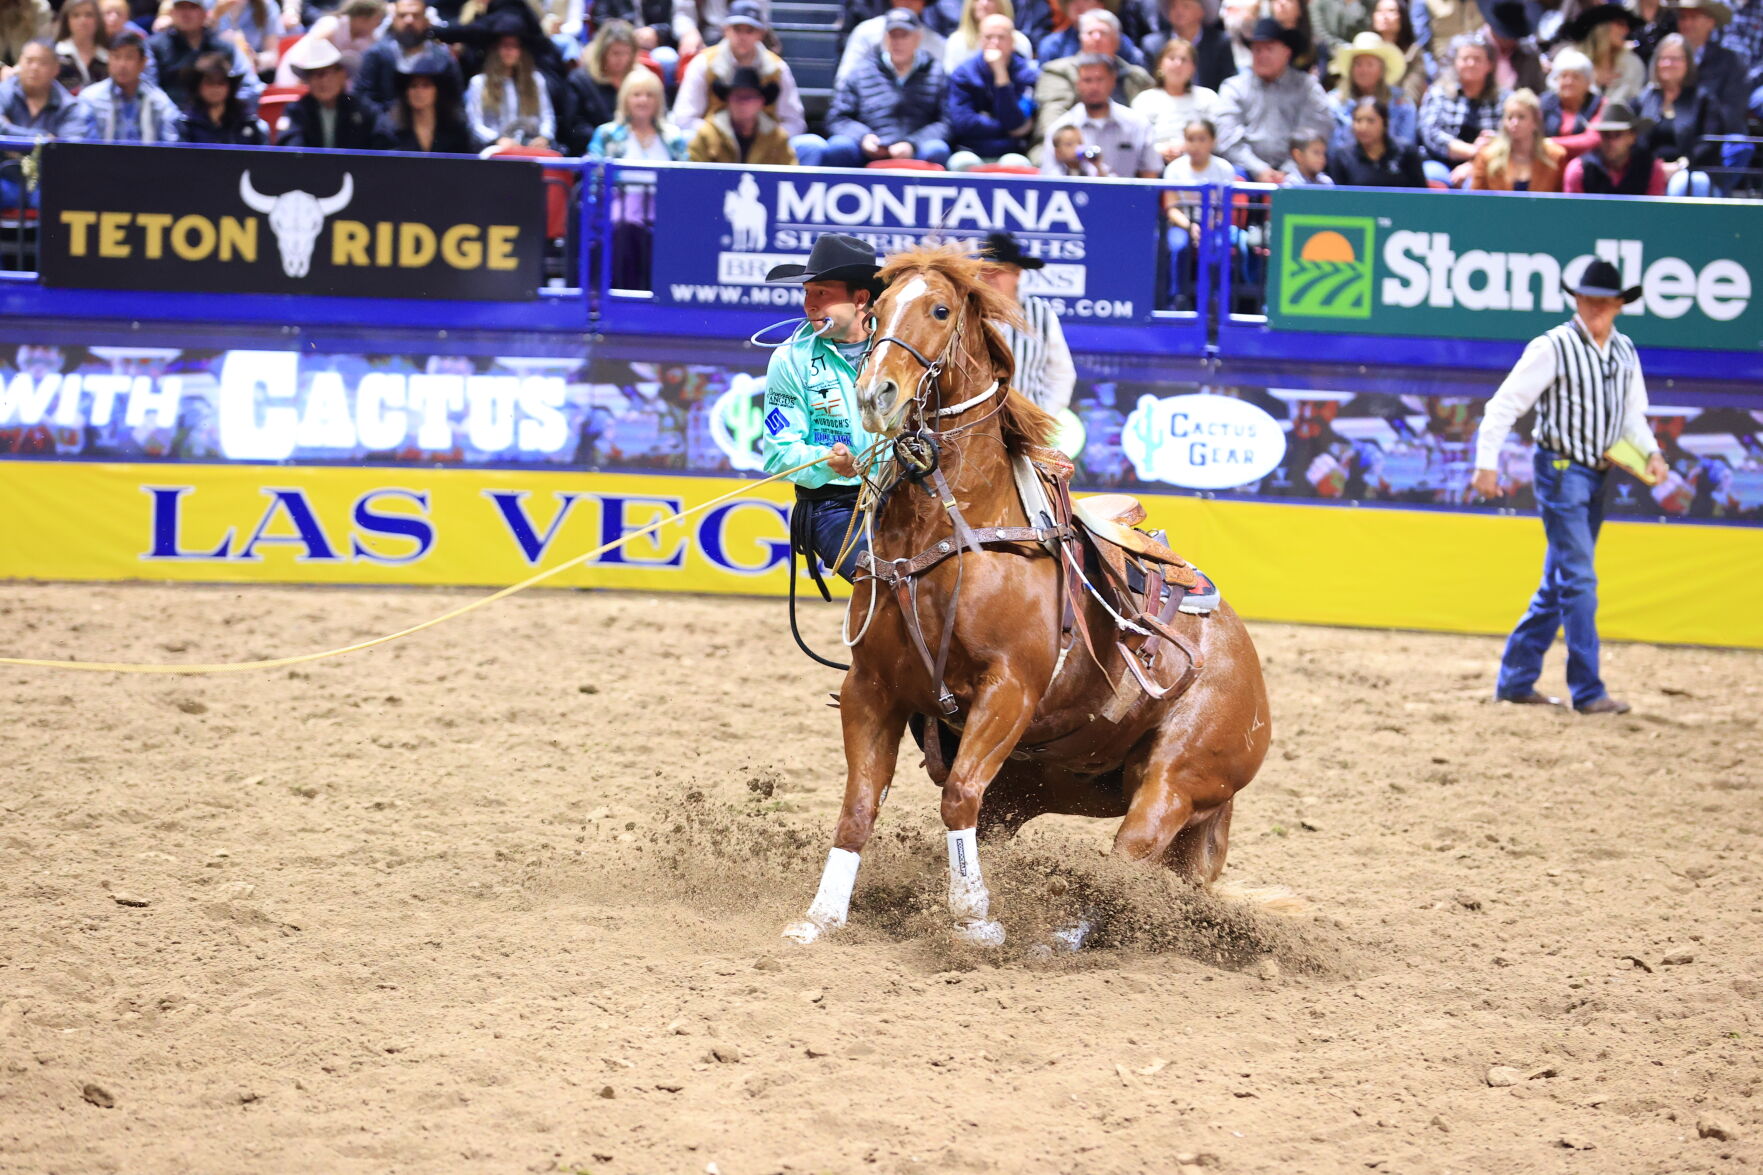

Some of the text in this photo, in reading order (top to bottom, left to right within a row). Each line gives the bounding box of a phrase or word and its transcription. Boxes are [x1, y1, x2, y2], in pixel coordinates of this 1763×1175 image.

[60, 210, 520, 271] TETON RIDGE
[776, 180, 1085, 234] MONTANA
[0, 349, 570, 460] WITH CACTUS
[137, 485, 834, 577] LAS VEG
